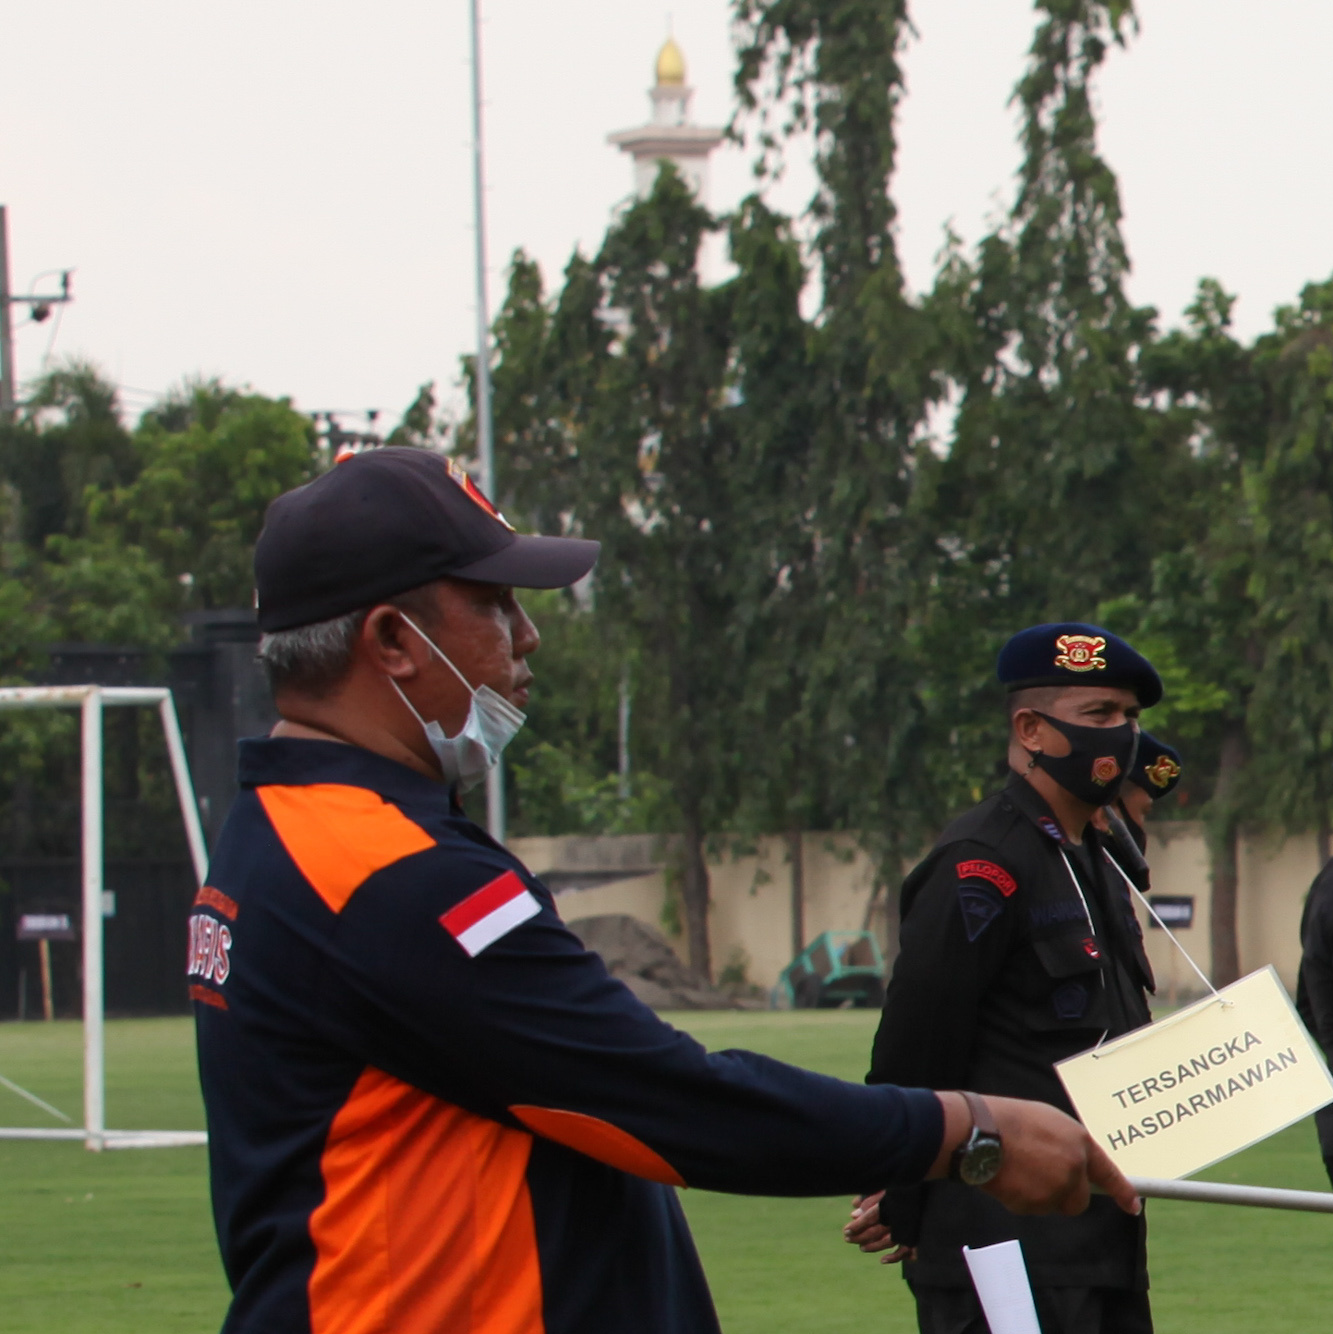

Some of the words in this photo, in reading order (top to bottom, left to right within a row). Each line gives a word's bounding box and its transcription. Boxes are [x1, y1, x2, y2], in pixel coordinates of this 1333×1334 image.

[960, 861, 1014, 893] PELOPOR
[1107, 1047, 1298, 1151] HASDARMAWAN
[1112, 1030, 1262, 1109] TERSANGKA
